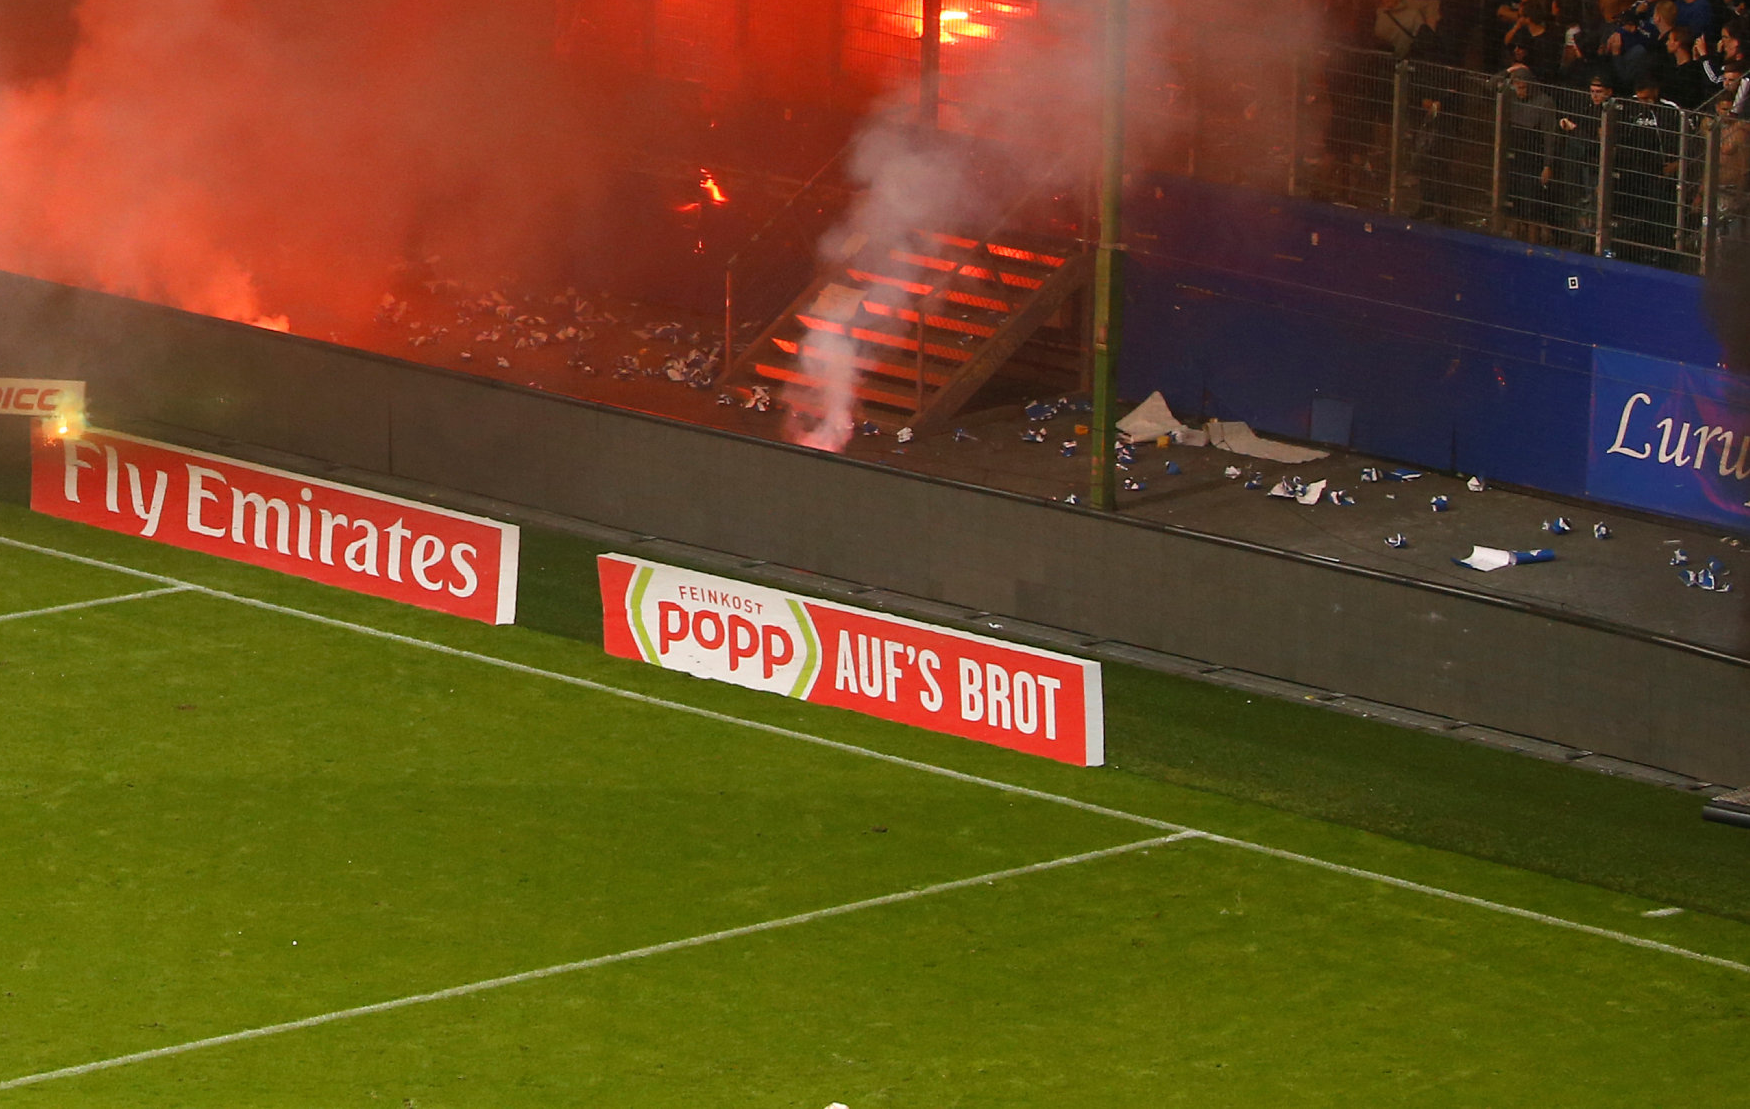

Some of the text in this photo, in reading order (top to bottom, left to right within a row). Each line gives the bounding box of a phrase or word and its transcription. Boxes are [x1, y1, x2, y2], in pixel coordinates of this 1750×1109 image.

[62, 438, 479, 598] Fly Emirates
[677, 585, 763, 615] FEINKOST
[834, 628, 1061, 740] AUF'S BROT
